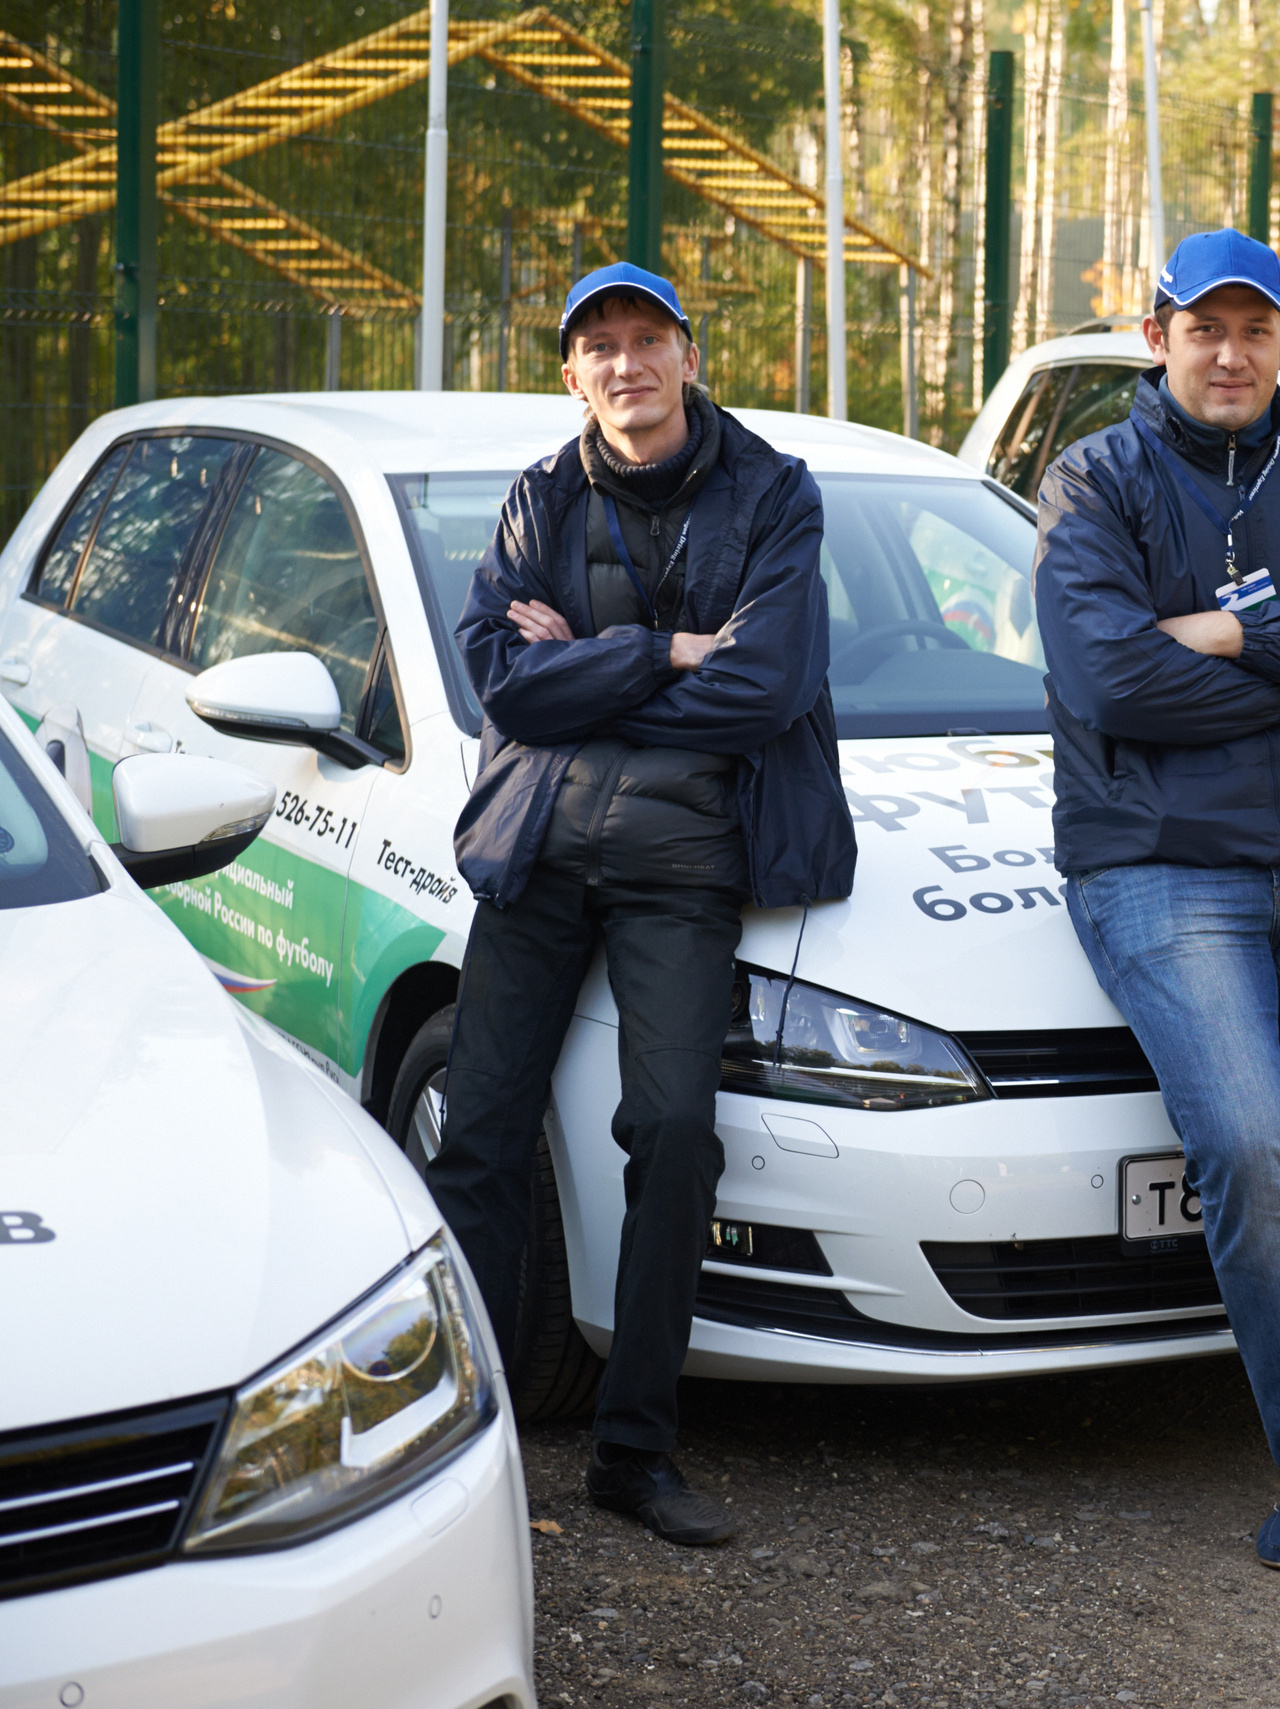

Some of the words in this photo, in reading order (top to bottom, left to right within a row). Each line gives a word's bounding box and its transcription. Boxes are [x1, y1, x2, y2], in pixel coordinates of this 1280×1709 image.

[275, 790, 358, 849] 526-75-11
[842, 771, 1057, 833] фут
[376, 838, 459, 904] Тест-драйв
[213, 890, 255, 939] России
[257, 922, 273, 949] по
[275, 928, 334, 988] футболу
